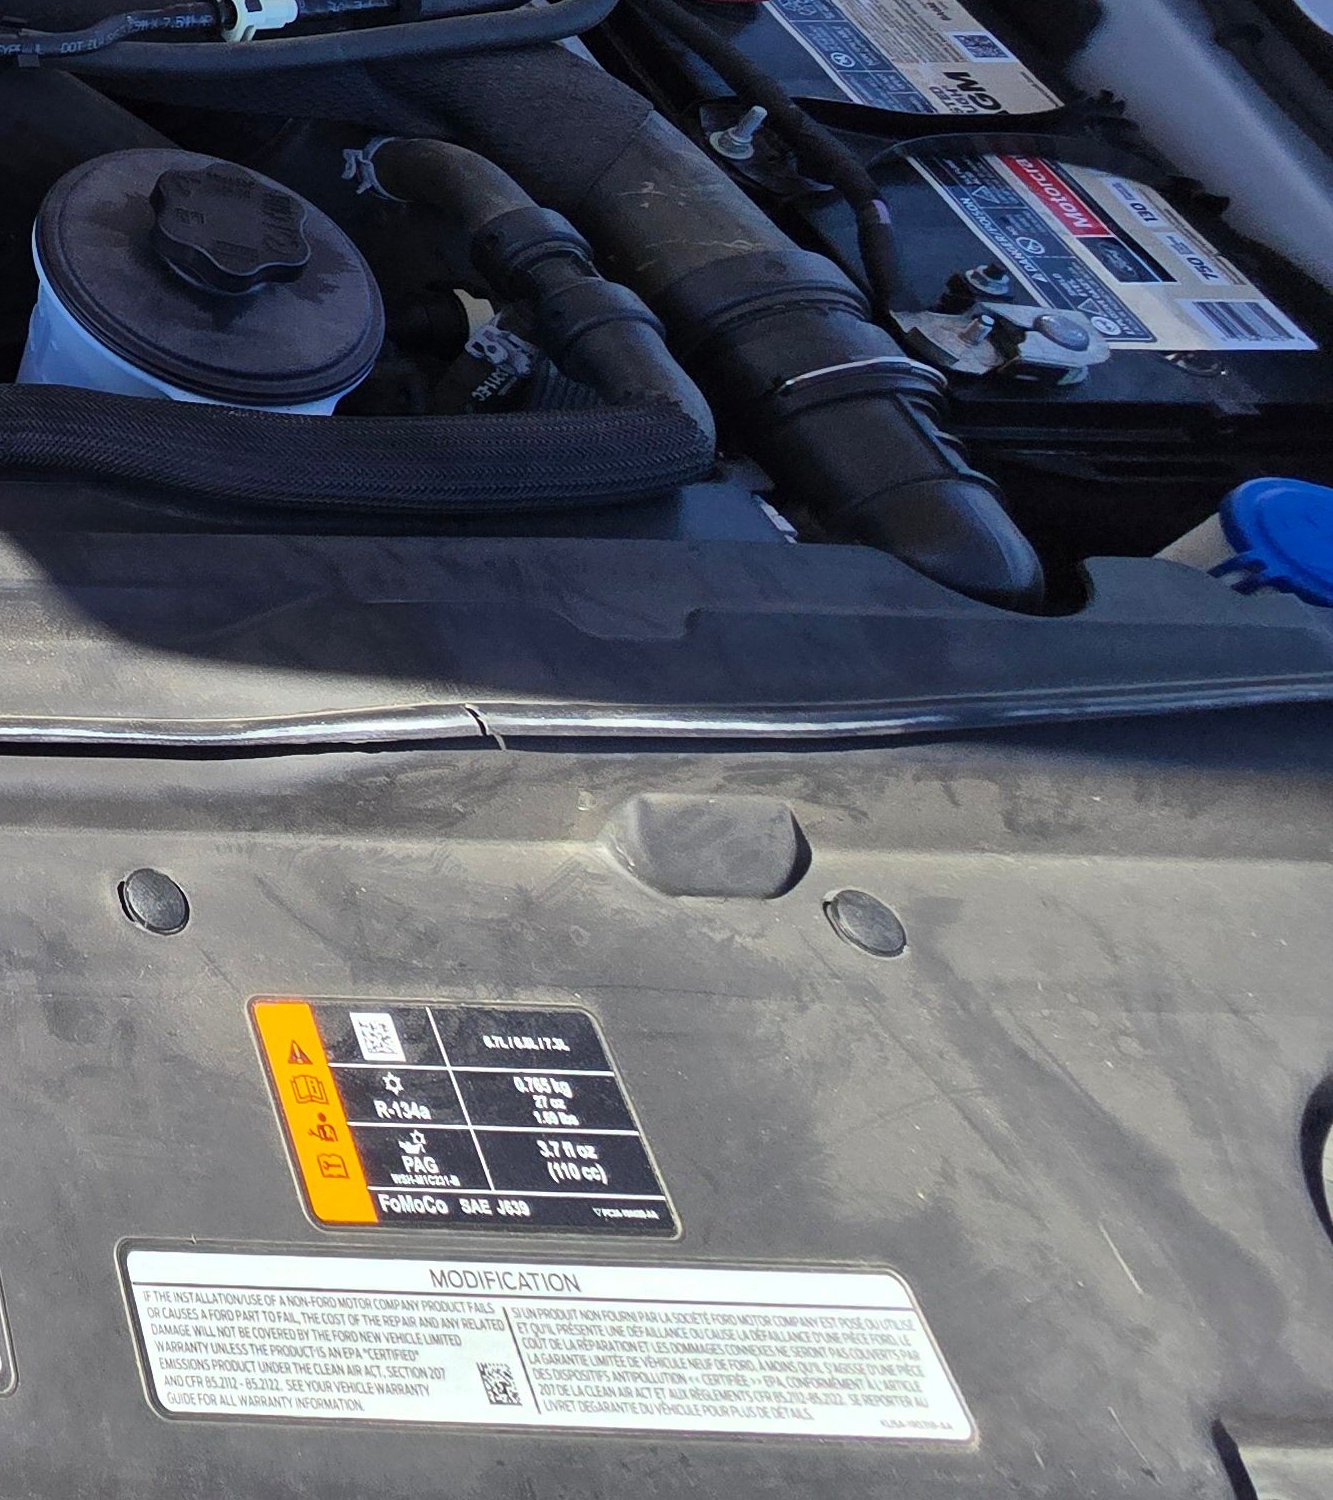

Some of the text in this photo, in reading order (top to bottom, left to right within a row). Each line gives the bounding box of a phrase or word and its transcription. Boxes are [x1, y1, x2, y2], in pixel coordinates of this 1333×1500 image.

[943, 72, 1005, 112] GM
[1014, 155, 1094, 230] Motorcra
[1129, 201, 1157, 224] 130
[956, 196, 1039, 272] DANGER/POISON
[1187, 256, 1219, 280] 750
[511, 1076, 574, 1098] 0.765 kg
[372, 1099, 432, 1120] R-134a
[531, 1095, 567, 1110] 27 oz
[535, 1139, 600, 1160] 3.7 fl oz
[400, 1155, 440, 1174] PAG
[545, 1161, 610, 1185] (110 cc)
[376, 1193, 532, 1217] FoMoCo SAE J639
[427, 1268, 583, 1292] MODIFICATION
[142, 1289, 496, 1314] IF THE INSTALLATION/USE OF A NON-FORD MOTOR COMPANY PRODUCT FAILS
[145, 1306, 507, 1331] OR CAUSES A FORD PART TO FAIL, THE COST OF THE REPAIR AND ANY RELATED
[149, 1323, 464, 1346] DAMAGE WILL NOT BE COVERED BY THE FORD NEW VEHICLE LIMITED
[153, 1340, 210, 1355] WARRANTY
[209, 1341, 249, 1356] UNLESS
[247, 1343, 270, 1357] THE
[267, 1343, 317, 1358] PRODUCT
[314, 1345, 328, 1359] IS
[325, 1345, 344, 1359] AN
[340, 1345, 363, 1360] EPA
[157, 1357, 212, 1371] EMISSIONS
[209, 1358, 258, 1373] PRODUCT
[256, 1360, 293, 1374] UNDER
[291, 1361, 313, 1375] THE
[311, 1362, 347, 1376] CLEAN
[343, 1363, 364, 1377] AIR
[384, 1364, 429, 1379] SECTION
[426, 1366, 448, 1380] 207
[162, 1374, 185, 1388] AND
[183, 1375, 204, 1389] CFR
[203, 1375, 239, 1390] 85.2112
[284, 1378, 305, 1392] SEE
[303, 1379, 334, 1393] YOUR
[332, 1380, 376, 1395] VEHICLE
[373, 1381, 432, 1397] WARRANTY
[165, 1391, 197, 1406] GUIDE
[195, 1392, 218, 1406] FOR
[217, 1392, 238, 1407] ALL
[236, 1393, 294, 1409] WARRANTY
